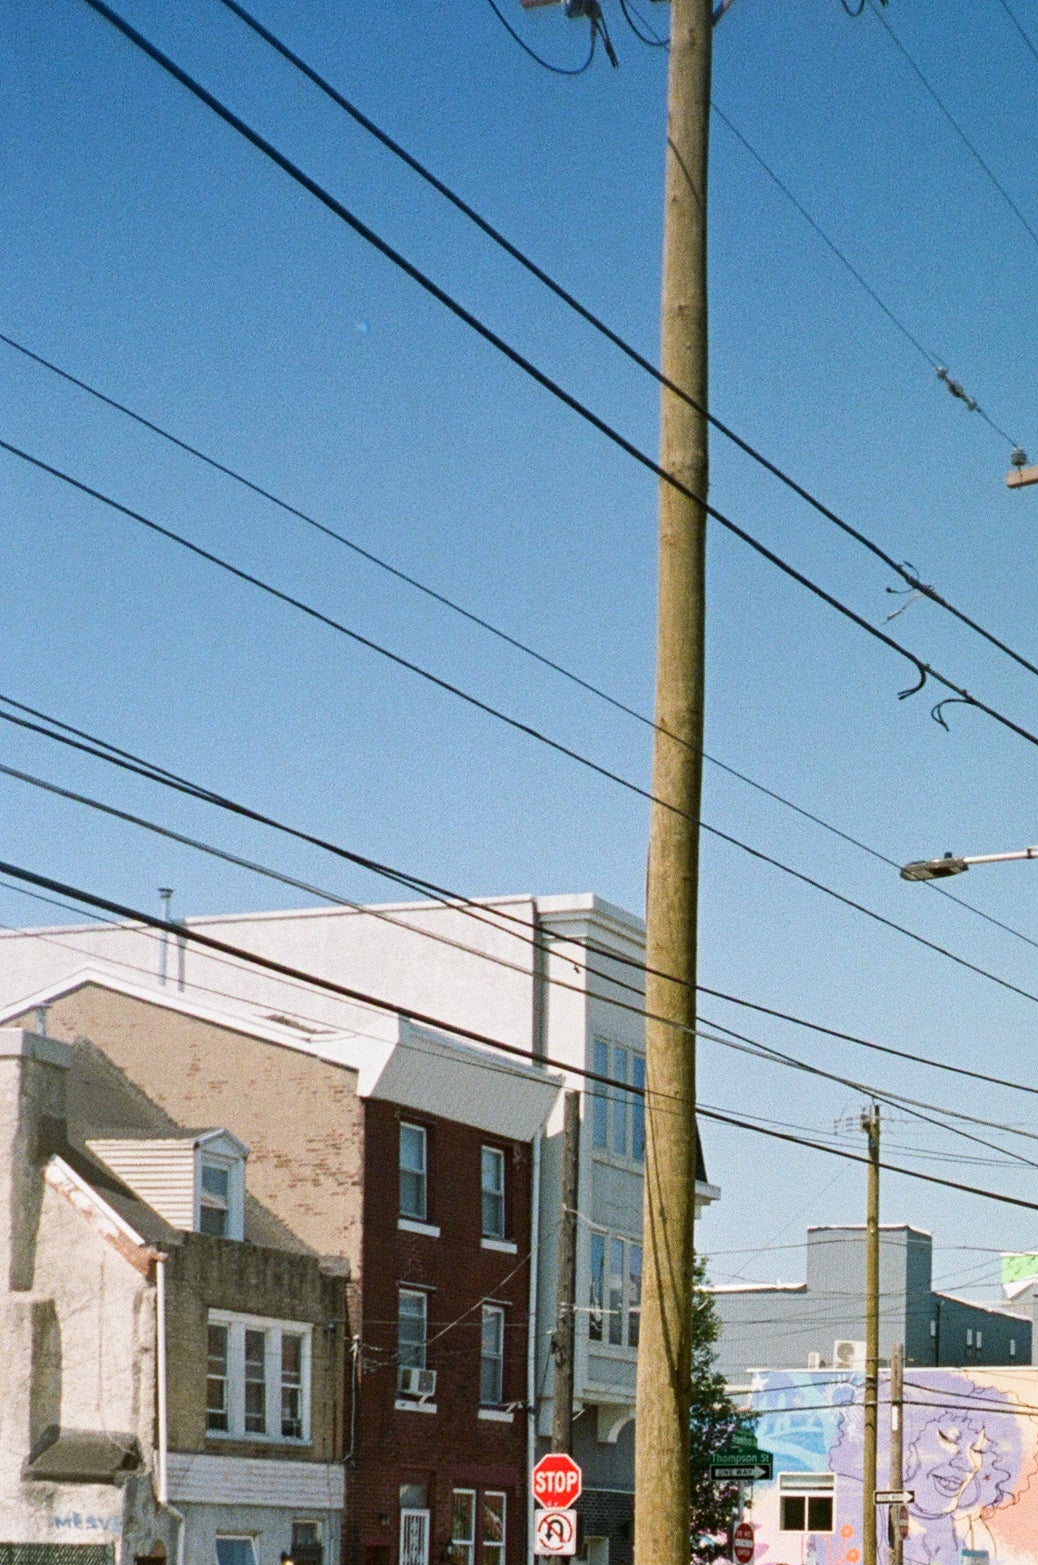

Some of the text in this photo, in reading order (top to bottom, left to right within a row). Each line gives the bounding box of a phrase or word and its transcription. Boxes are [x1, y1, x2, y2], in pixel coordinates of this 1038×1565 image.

[712, 1453, 769, 1465] Thompson St
[715, 1468, 752, 1477] ONE WAY
[535, 1470, 577, 1494] STOP
